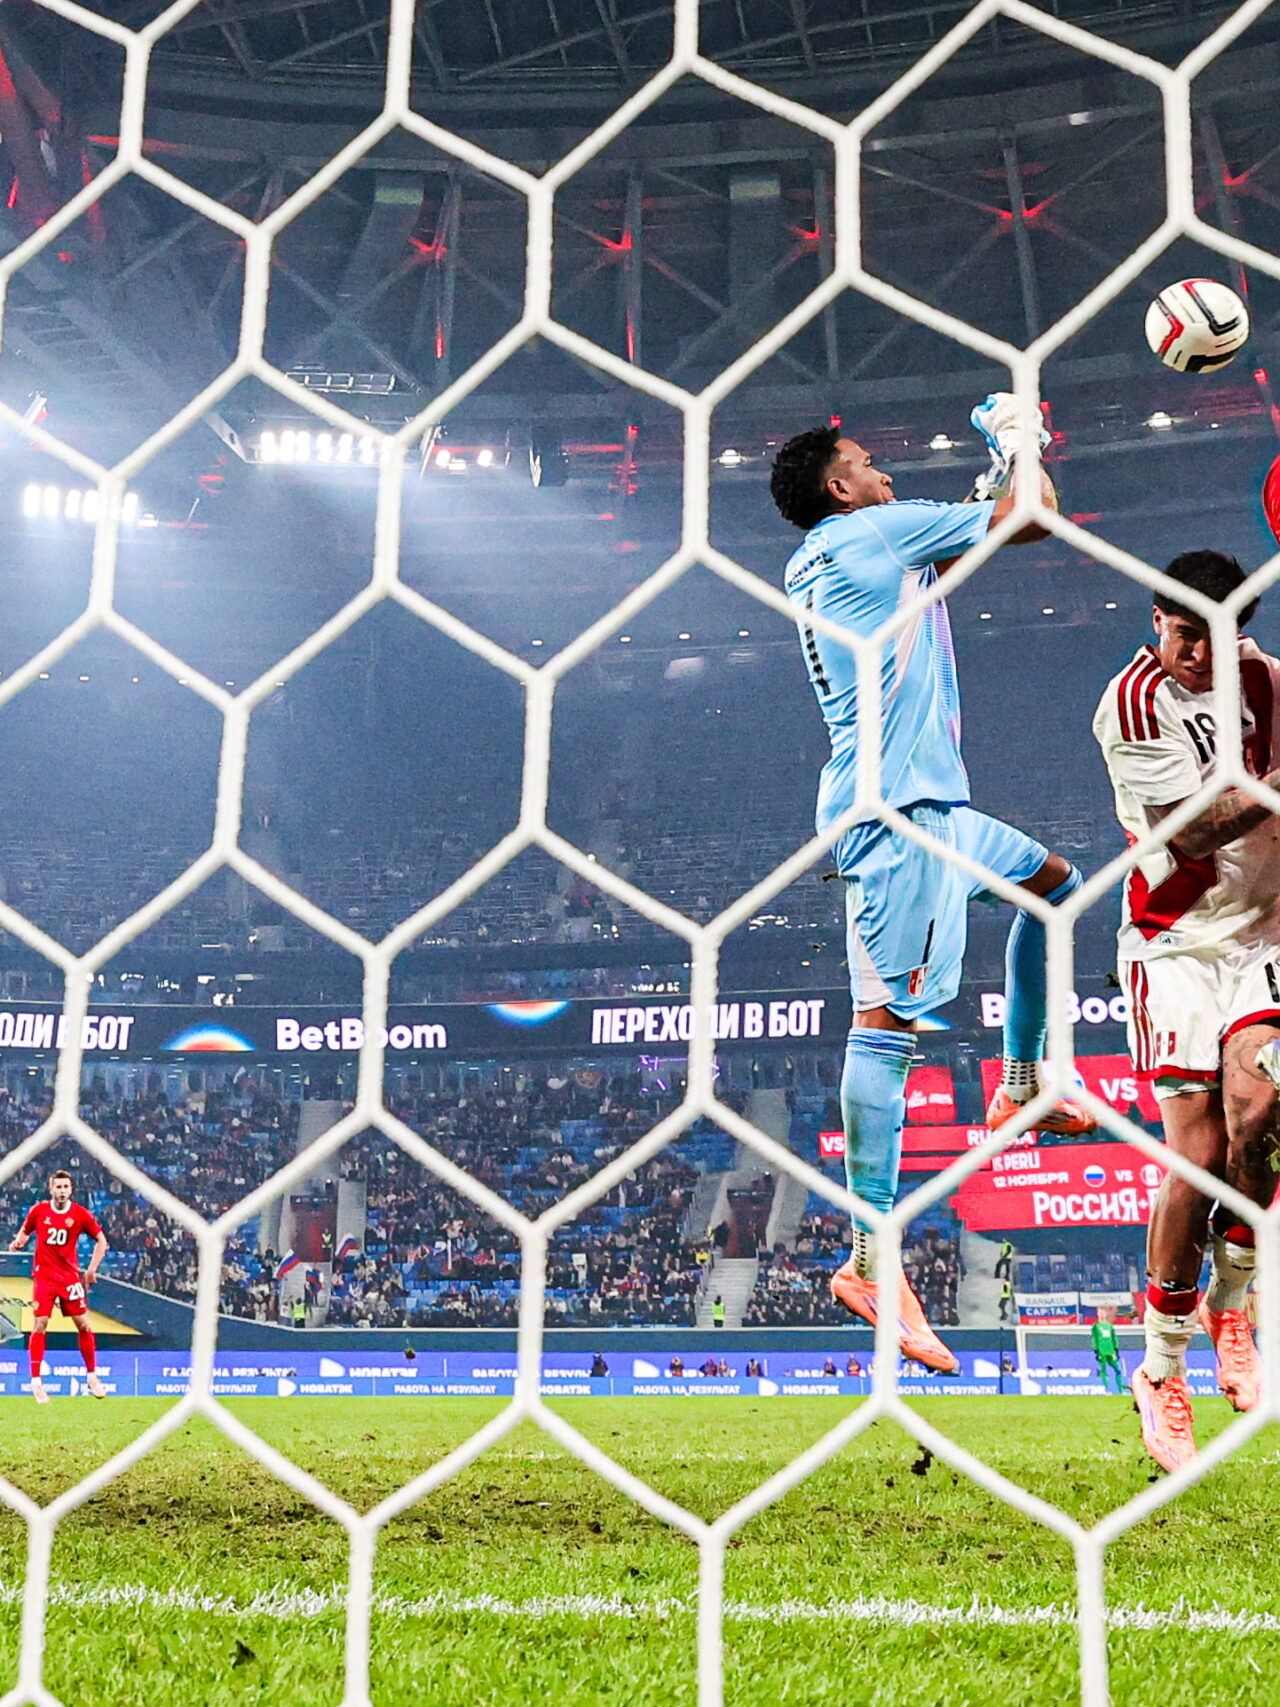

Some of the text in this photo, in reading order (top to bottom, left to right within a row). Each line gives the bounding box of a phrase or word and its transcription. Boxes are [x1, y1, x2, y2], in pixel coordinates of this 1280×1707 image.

[744, 1002, 764, 1039] В
[768, 999, 825, 1038] БОТ
[80, 1015, 135, 1051] БОТ
[1101, 1077, 1140, 1102] VS
[822, 1136, 845, 1152] VS
[1007, 1171, 1069, 1187] НОЯБРЯ
[46, 1227, 68, 1246] 20
[66, 1282, 85, 1301] 20
[300, 1383, 354, 1394] НОВАТЭК
[394, 1384, 497, 1394] РАБОТА НА РЕЗУЛЬТАТ
[633, 1385, 670, 1394] РАБОТА
[689, 1385, 741, 1395] РЕЗУЛЬТАТ
[782, 1384, 840, 1395] НОВАТЭК
[926, 1385, 942, 1395] НА
[943, 1385, 998, 1395] РЕЗУЛЬТАТ
